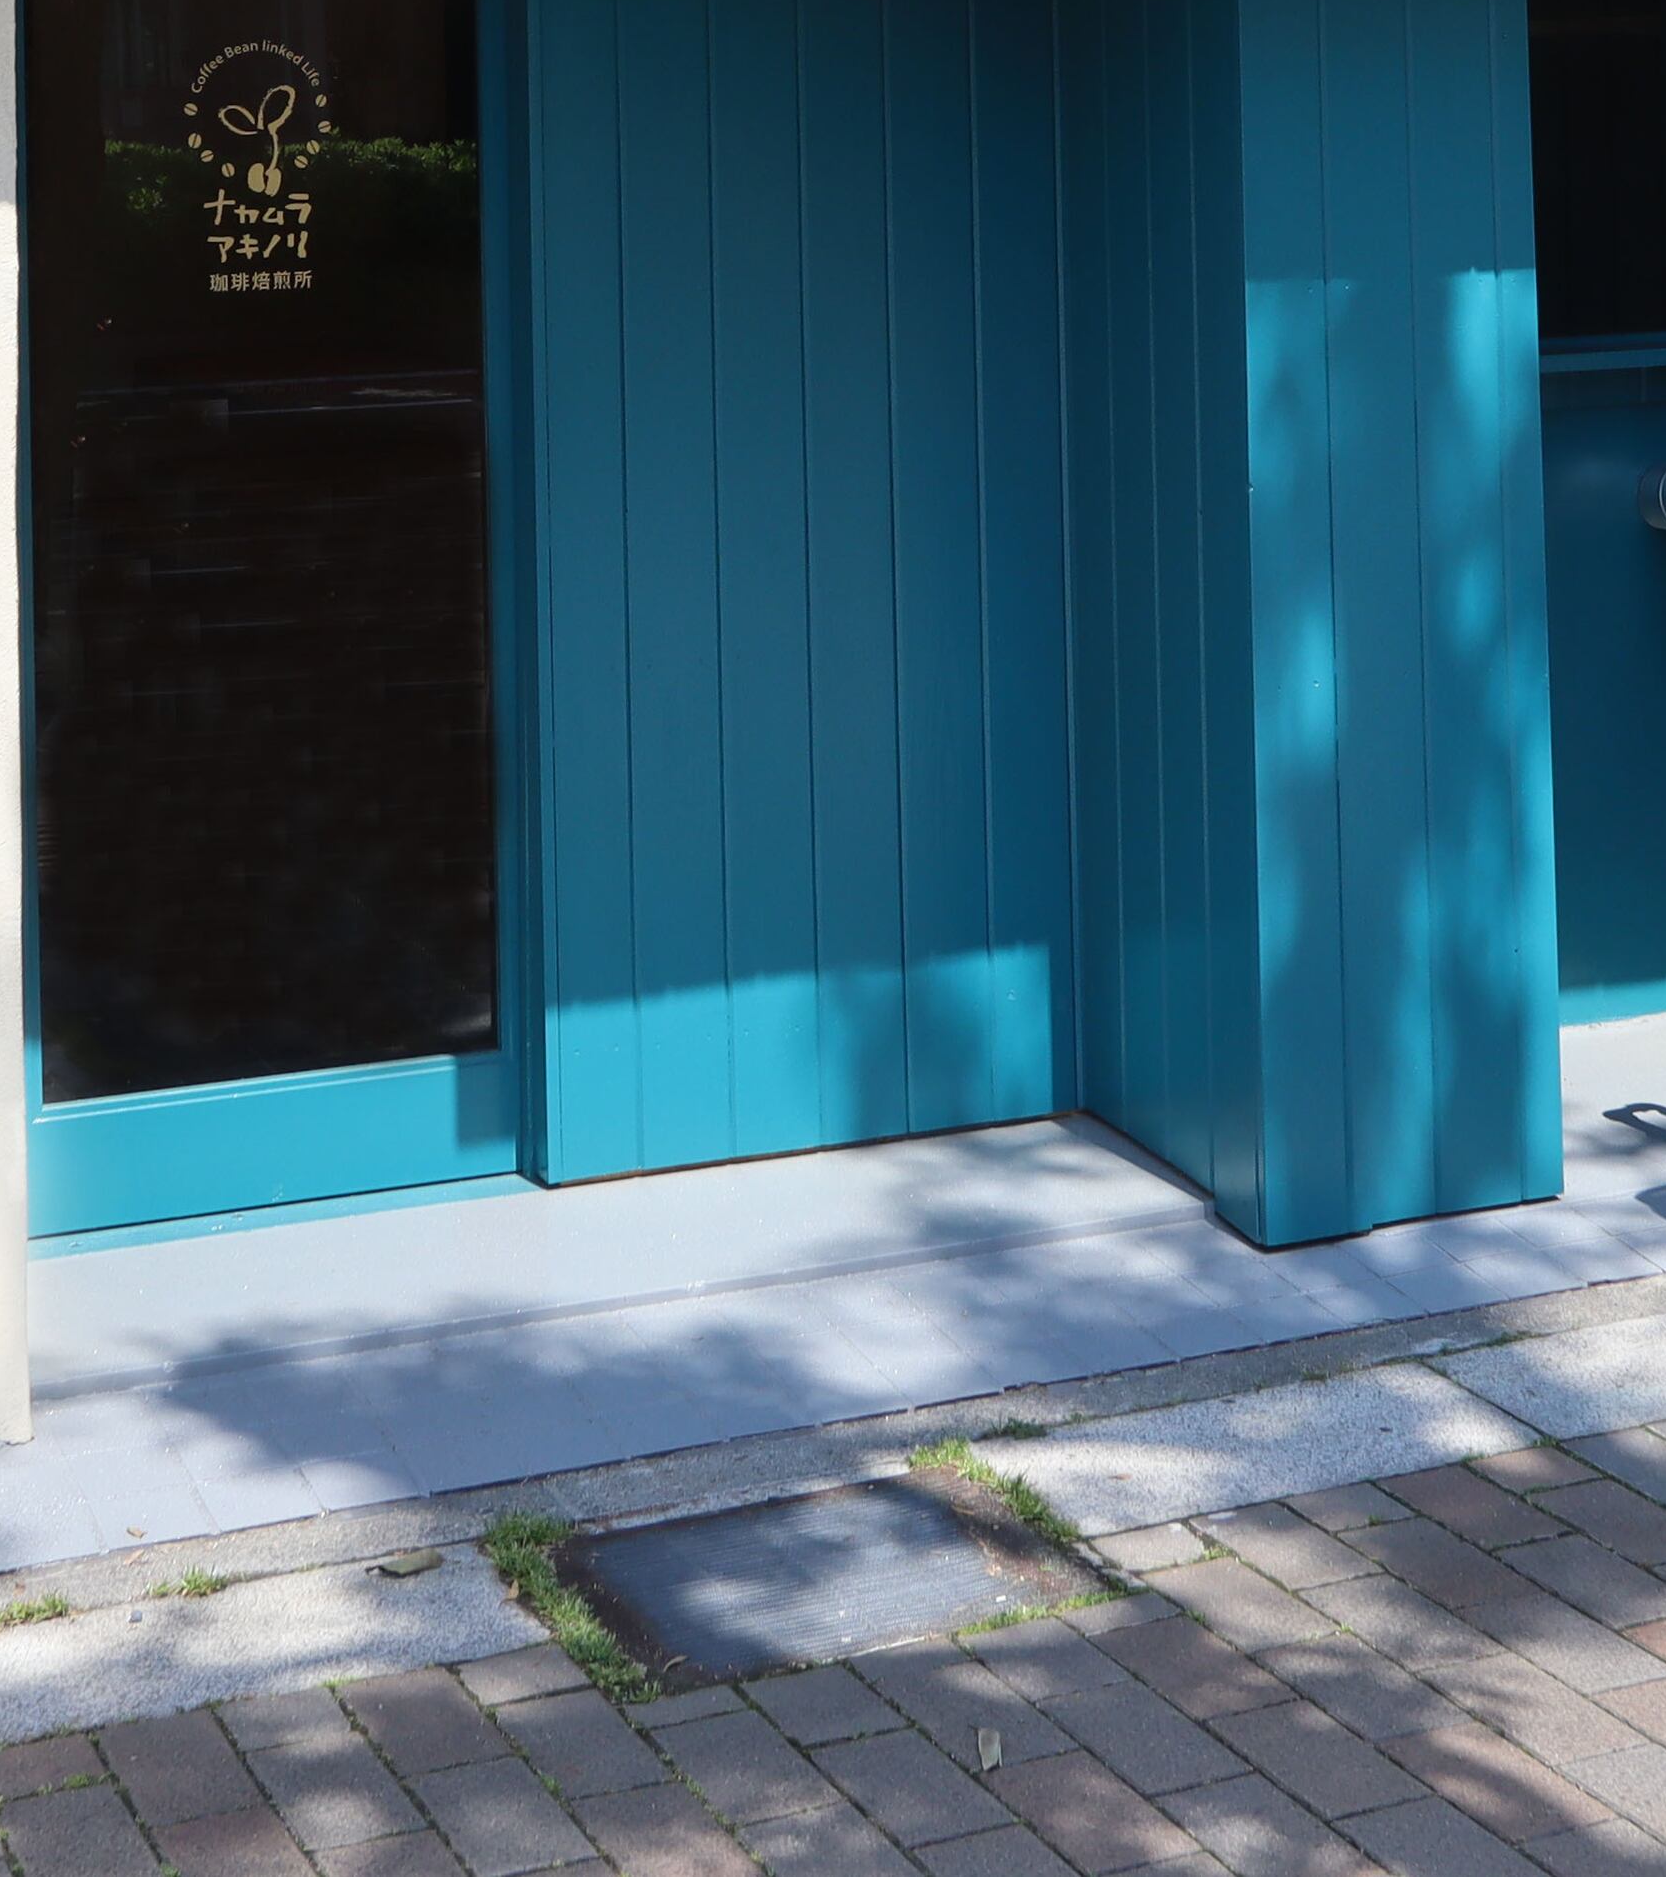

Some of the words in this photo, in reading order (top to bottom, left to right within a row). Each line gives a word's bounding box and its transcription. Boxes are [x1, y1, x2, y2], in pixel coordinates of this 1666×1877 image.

[190, 54, 225, 94] Coffee
[223, 41, 259, 59] Bean
[261, 39, 305, 66] linked
[300, 61, 321, 88] Life
[203, 188, 312, 226] ナカムラ
[206, 230, 309, 264] アキノリ
[209, 269, 313, 293] 珈琲焙煎所
